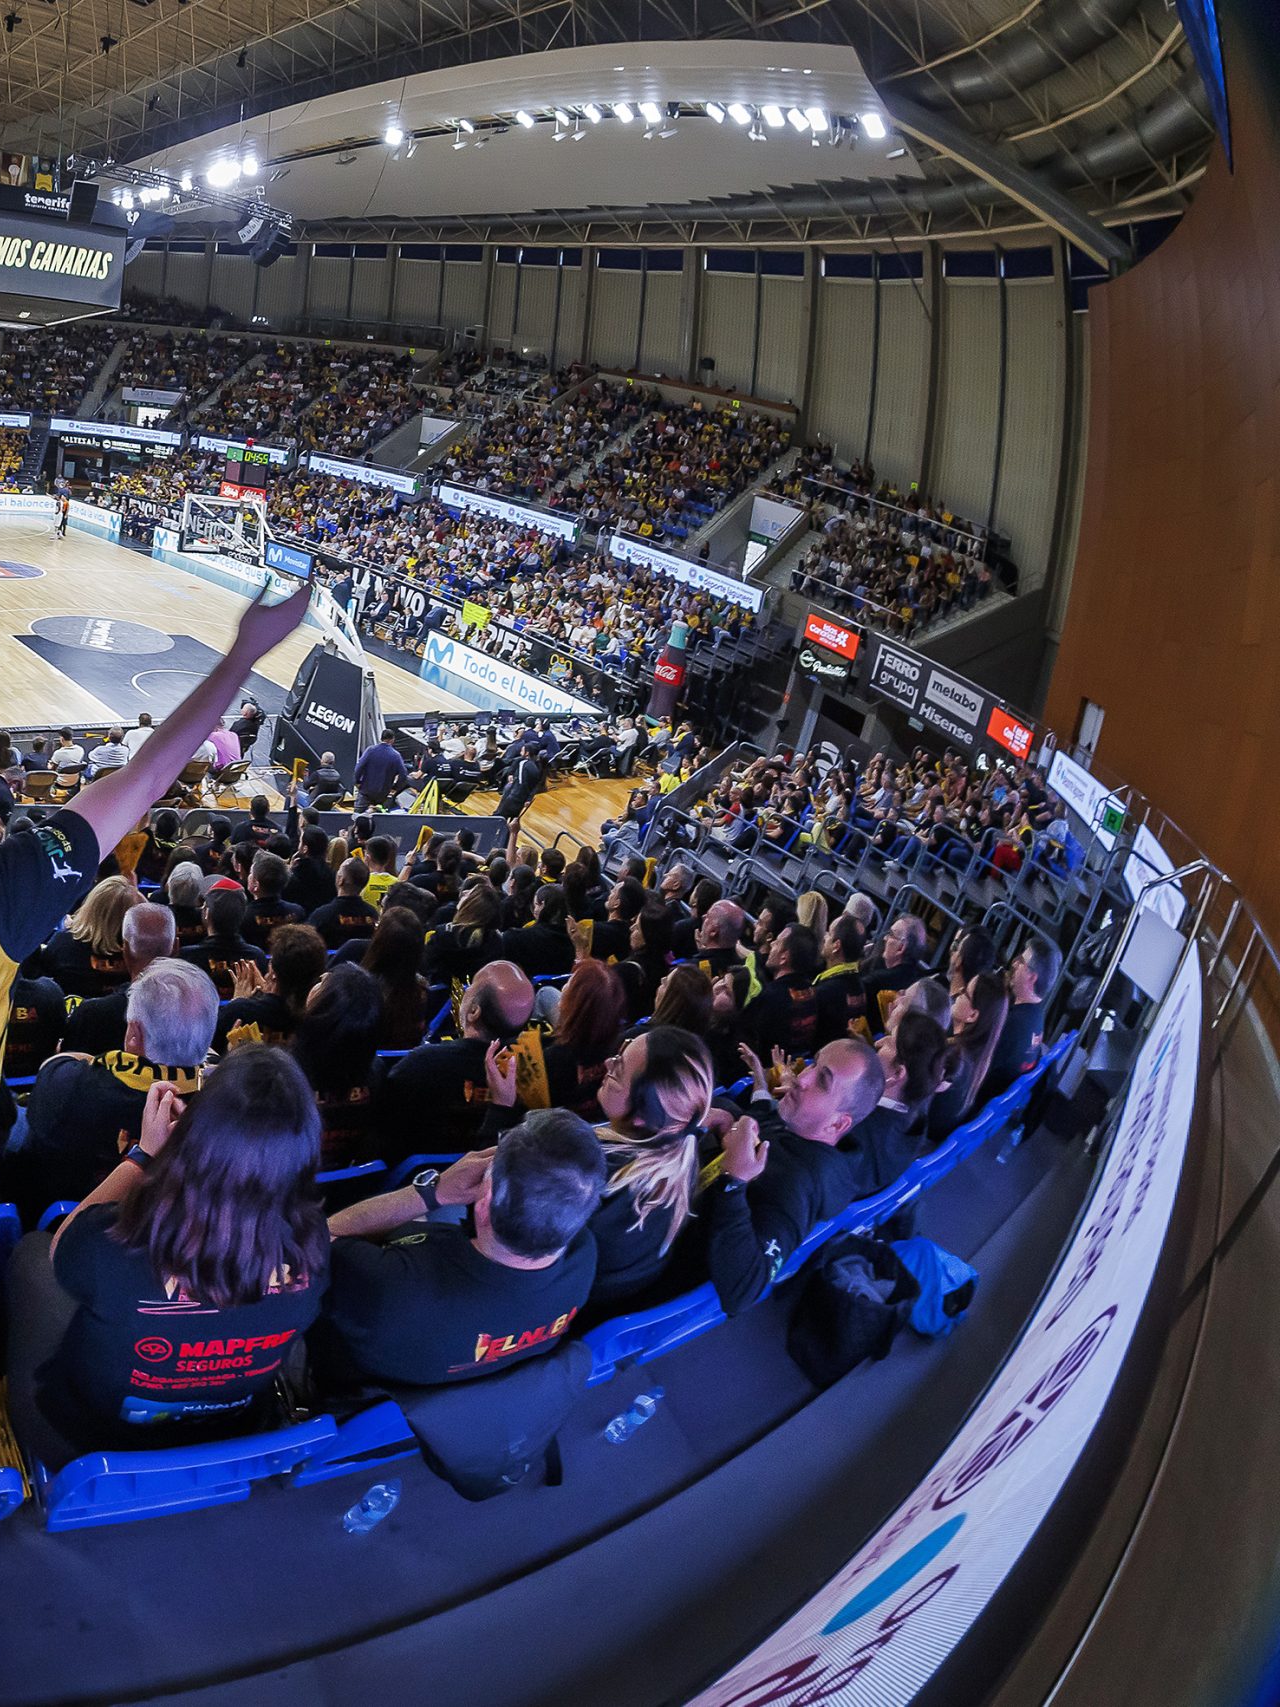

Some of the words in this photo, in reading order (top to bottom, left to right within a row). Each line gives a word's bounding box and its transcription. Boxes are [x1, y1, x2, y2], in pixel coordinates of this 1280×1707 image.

[29, 241, 113, 280] CANARIAS
[245, 451, 269, 464] 04:55
[10, 498, 55, 509] balonces
[463, 653, 498, 684] Todo
[501, 676, 516, 693] el
[880, 670, 915, 697] grupo
[932, 679, 977, 713] metabo
[307, 701, 356, 734] LEGION
[918, 702, 974, 745] Hisense
[1107, 812, 1117, 826] R
[178, 1328, 297, 1358] MAPFRE
[175, 1354, 254, 1373] SEGUROS
